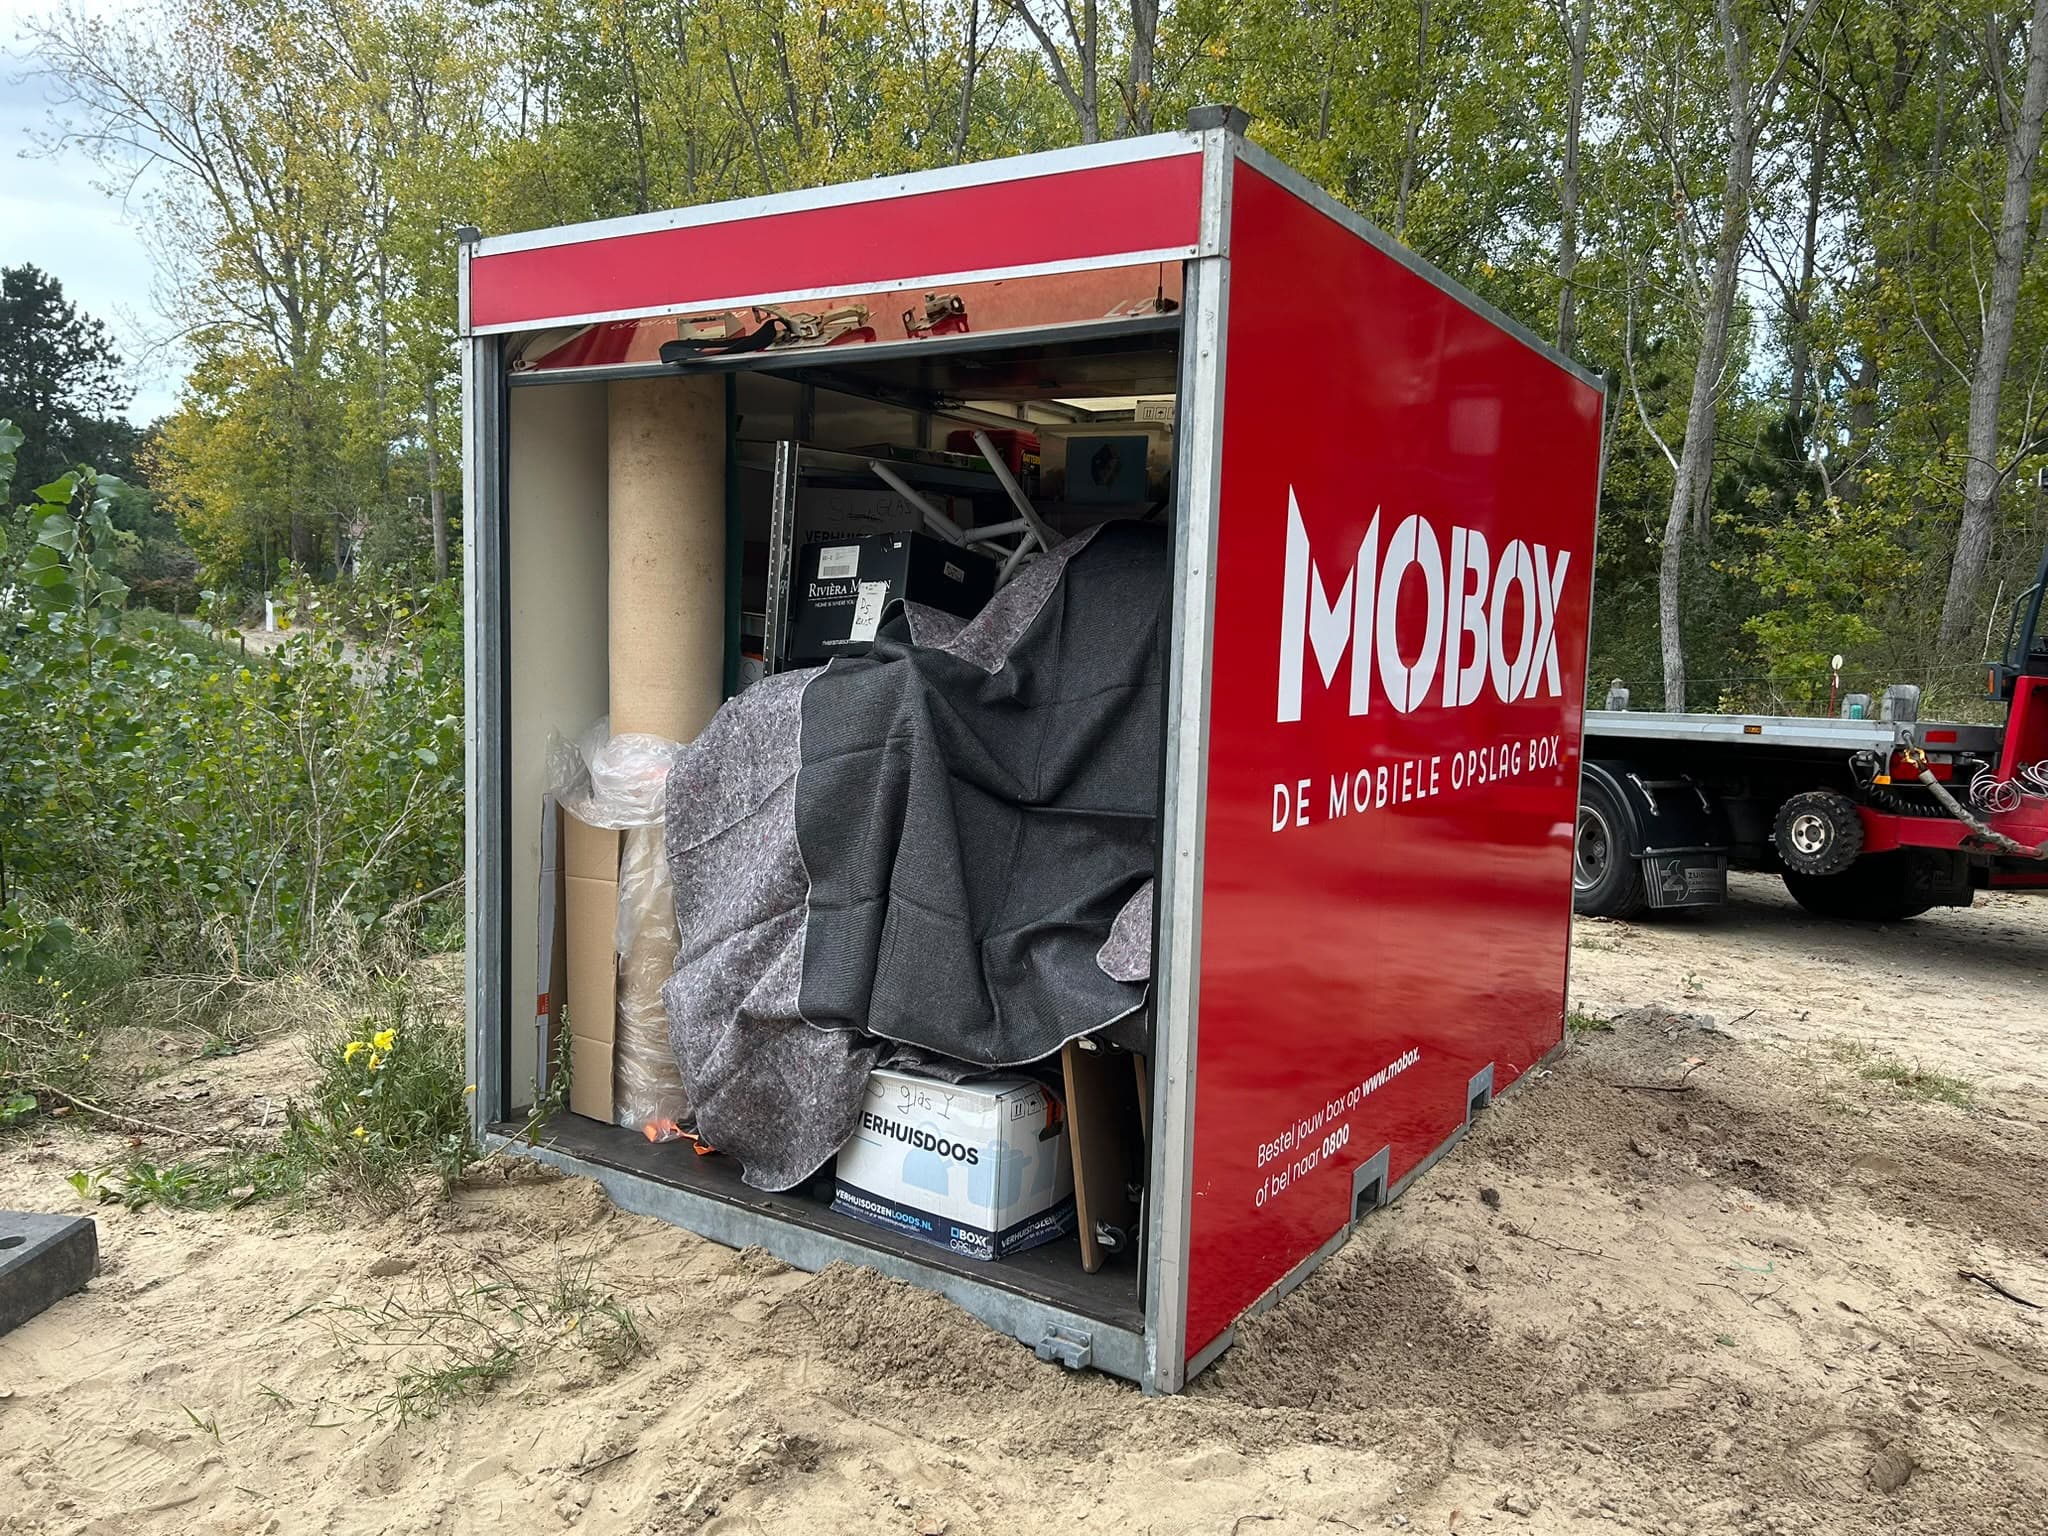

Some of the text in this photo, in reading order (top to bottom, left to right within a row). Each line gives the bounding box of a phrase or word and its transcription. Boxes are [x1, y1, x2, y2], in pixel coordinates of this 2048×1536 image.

[1277, 483, 1571, 722] MOBOX
[1272, 735, 1559, 832] DE MOBIELE OPSLAG BOX
[1257, 1046, 1421, 1168] Bestel jouw box op www.mobox.
[836, 1187, 933, 1231] VERHUISDOZENLOODS.NL
[1255, 1123, 1349, 1207] of bel naar 0800
